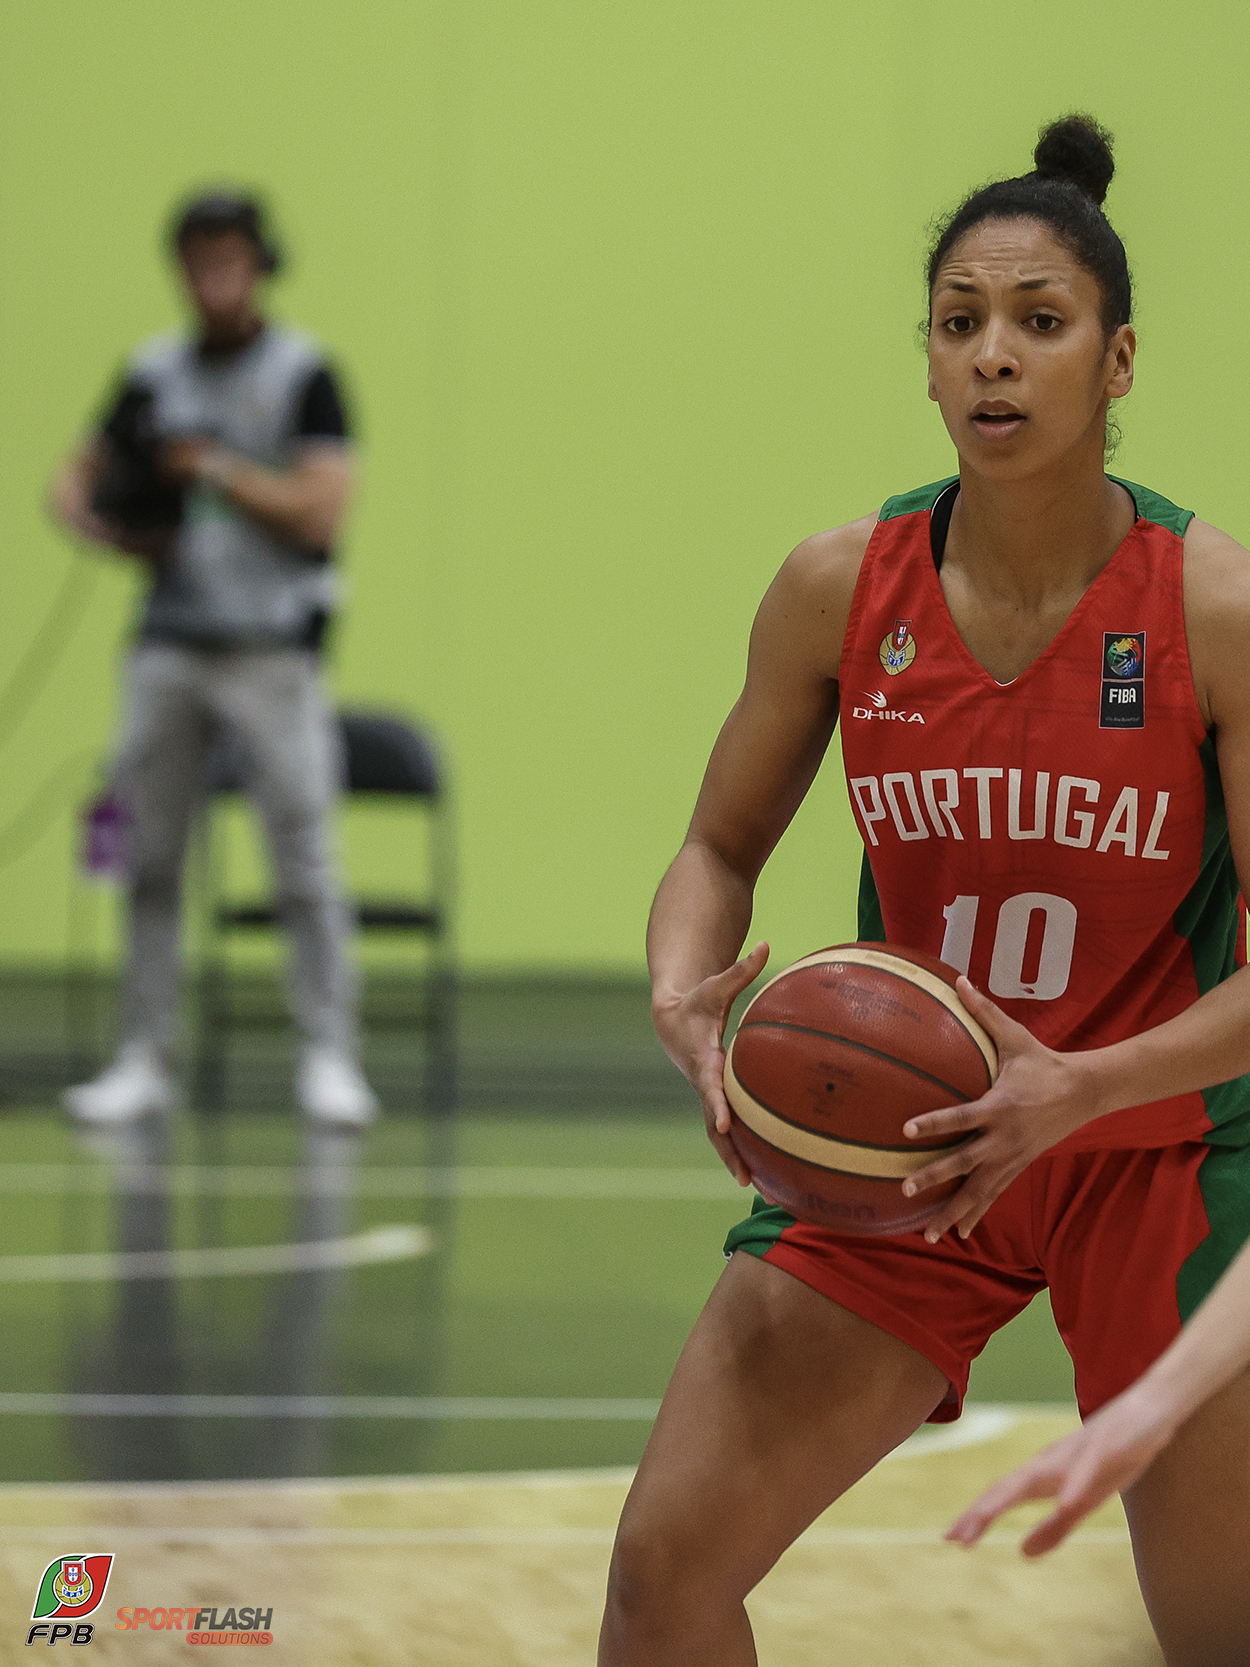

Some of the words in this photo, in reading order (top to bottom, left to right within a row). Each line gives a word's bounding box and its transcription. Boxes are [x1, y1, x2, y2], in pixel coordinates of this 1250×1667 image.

[851, 706, 926, 725] DHIKA
[1108, 686, 1137, 705] FIBA
[850, 767, 1171, 860] PORTUGAL
[940, 891, 1078, 1001] 10
